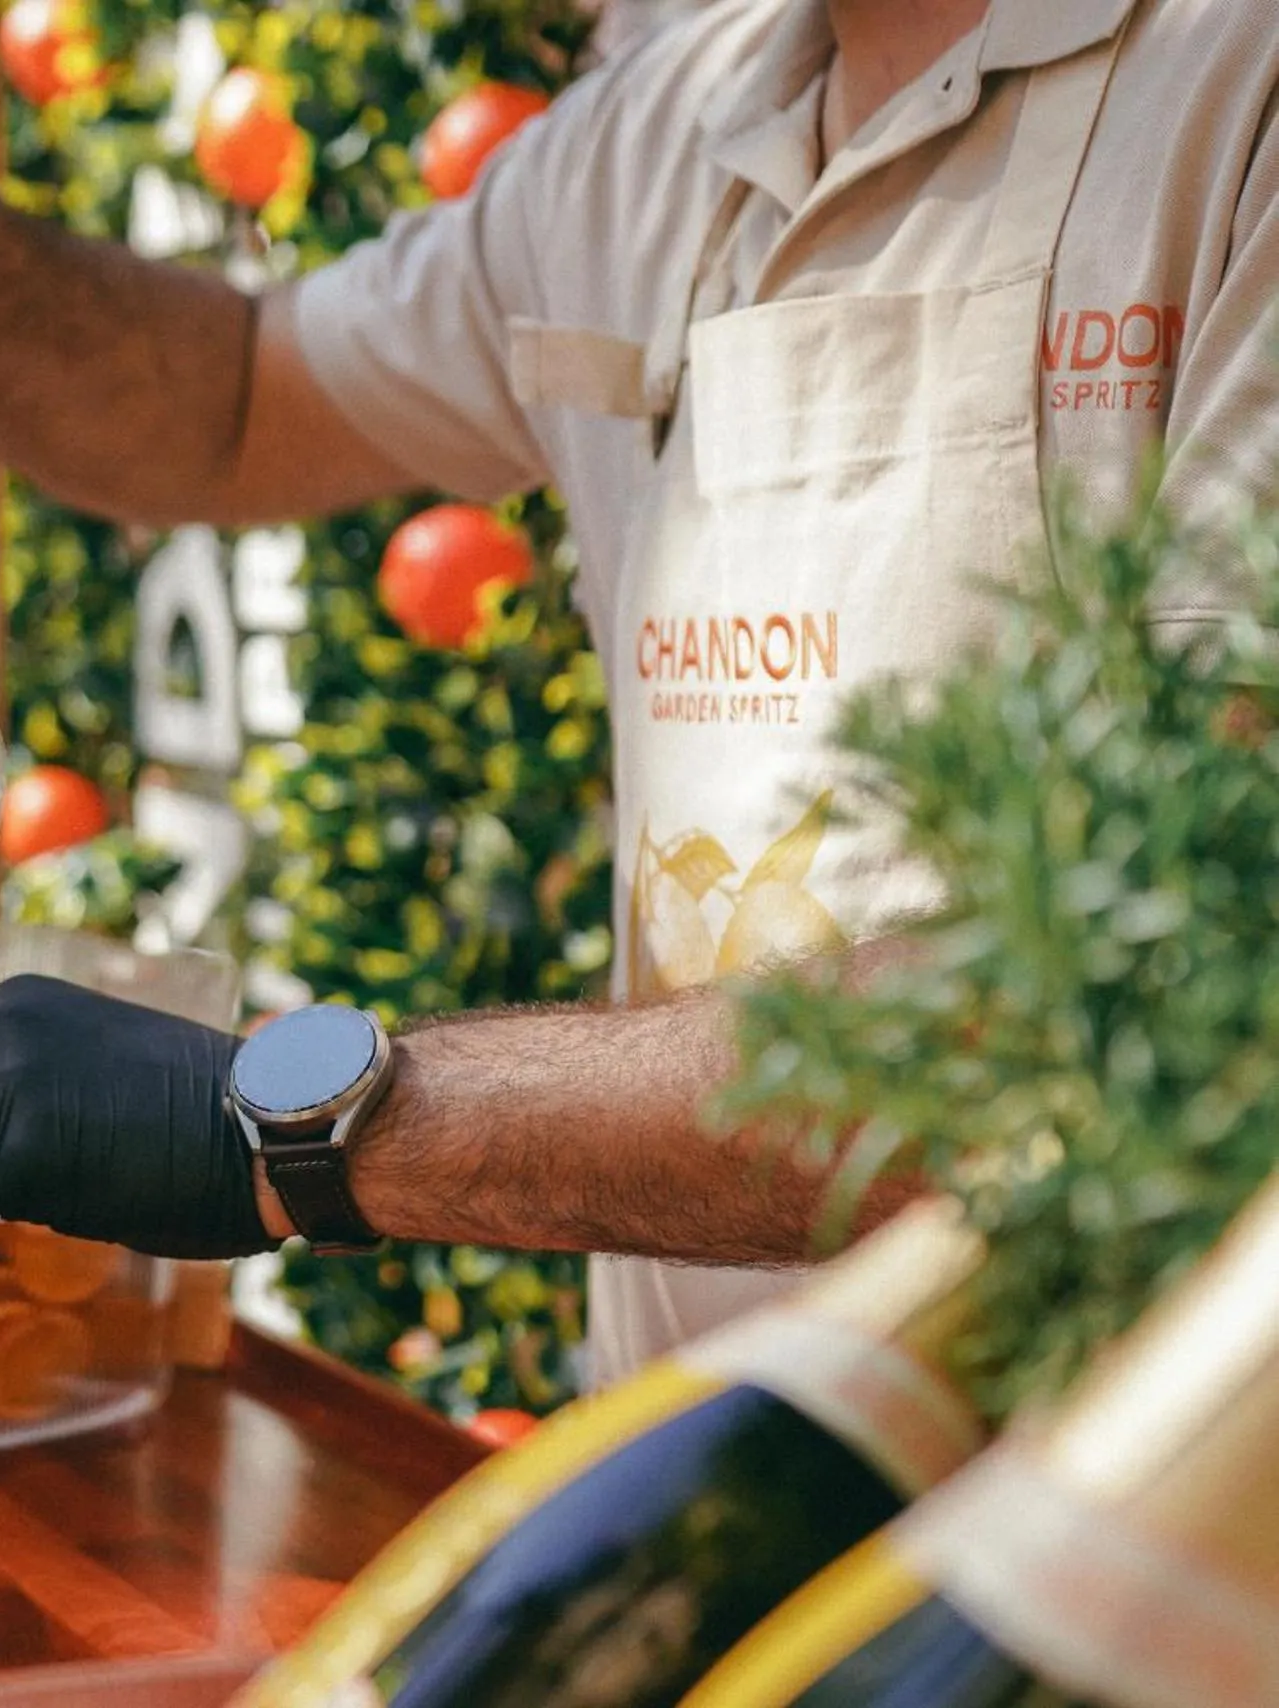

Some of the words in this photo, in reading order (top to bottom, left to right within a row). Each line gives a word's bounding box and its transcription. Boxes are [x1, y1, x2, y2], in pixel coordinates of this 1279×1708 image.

[1051, 380, 1161, 410] SPRITZ
[637, 611, 838, 681] CHANDON
[652, 692, 721, 723] GARDEN
[729, 692, 800, 723] SPRITZ
